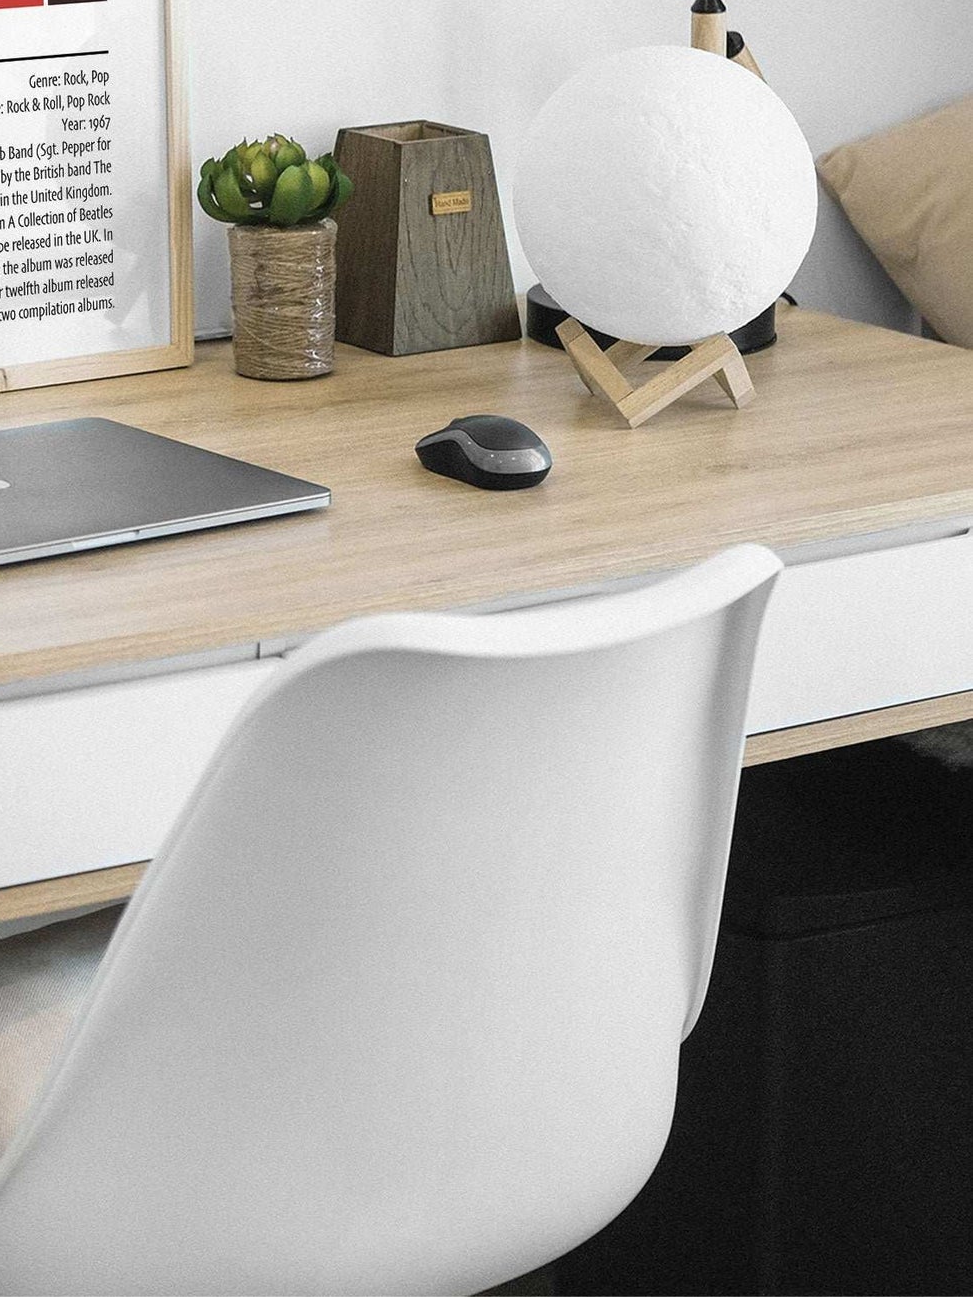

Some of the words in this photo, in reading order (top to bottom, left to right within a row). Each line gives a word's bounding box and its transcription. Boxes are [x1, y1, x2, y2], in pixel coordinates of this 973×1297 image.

[29, 75, 61, 88] Genre:
[64, 70, 89, 86] Rock,
[92, 70, 109, 86] Pop
[7, 98, 30, 114] Rock
[32, 98, 40, 111] &
[43, 95, 64, 111] Roll,
[67, 95, 85, 111] Pop
[88, 91, 110, 106] Rock
[62, 118, 86, 131] Year:
[89, 115, 111, 131] 1967
[9, 144, 33, 159] Band
[36, 143, 59, 160] (Sgt.
[62, 141, 95, 157] Pepper
[97, 137, 111, 151] for
[1, 169, 12, 187] by
[14, 167, 30, 182] the
[33, 163, 64, 180] British
[67, 161, 91, 177] band
[93, 159, 112, 174] The
[0, 193, 9, 206] in
[12, 191, 28, 205] the
[31, 186, 63, 203] United
[66, 183, 112, 202] Kingdom.
[12, 233, 51, 251] released
[54, 234, 63, 247] in
[66, 231, 81, 245] the
[84, 229, 101, 244] UK.
[104, 228, 113, 241] In
[5, 280, 40, 298] twelfth
[42, 278, 73, 294] album
[76, 271, 114, 291] released
[19, 301, 75, 321] compilation
[78, 297, 115, 312] albums.
